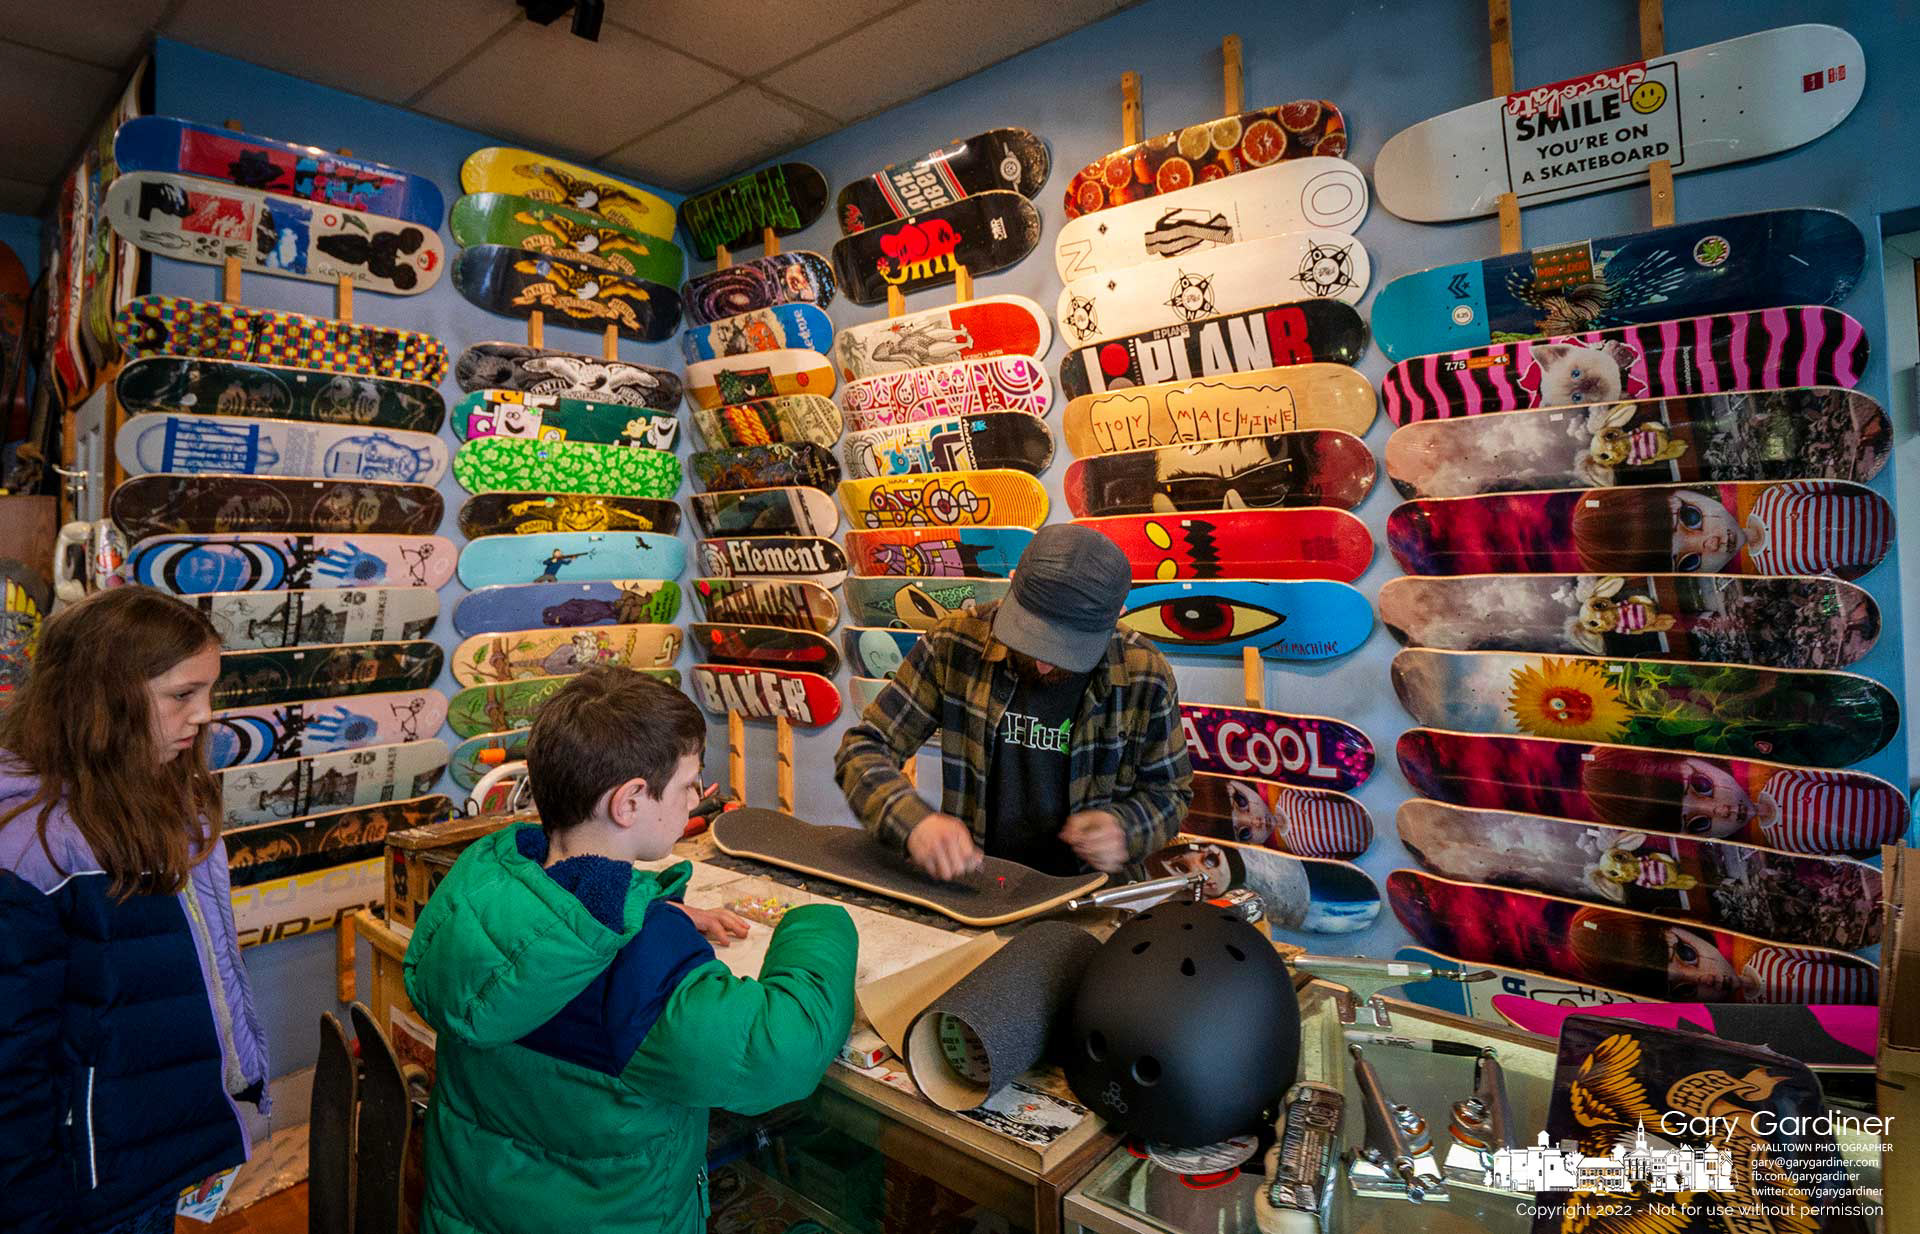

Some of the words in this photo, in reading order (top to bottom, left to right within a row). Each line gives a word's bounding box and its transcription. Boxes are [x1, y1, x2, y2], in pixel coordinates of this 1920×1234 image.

[1508, 68, 1646, 118] chocolate
[1516, 93, 1621, 142] SMILE
[1522, 171, 1535, 184] A
[1540, 142, 1670, 180] SKATEBOARD
[1537, 132, 1609, 160] YOU'RE
[1615, 124, 1648, 143] ON
[1445, 361, 1466, 371] 7.75
[1094, 414, 1142, 436] TOY
[1177, 409, 1294, 426] MACHINE
[727, 540, 830, 573] Element
[695, 669, 812, 723] BAKER
[1217, 721, 1338, 778] COOL
